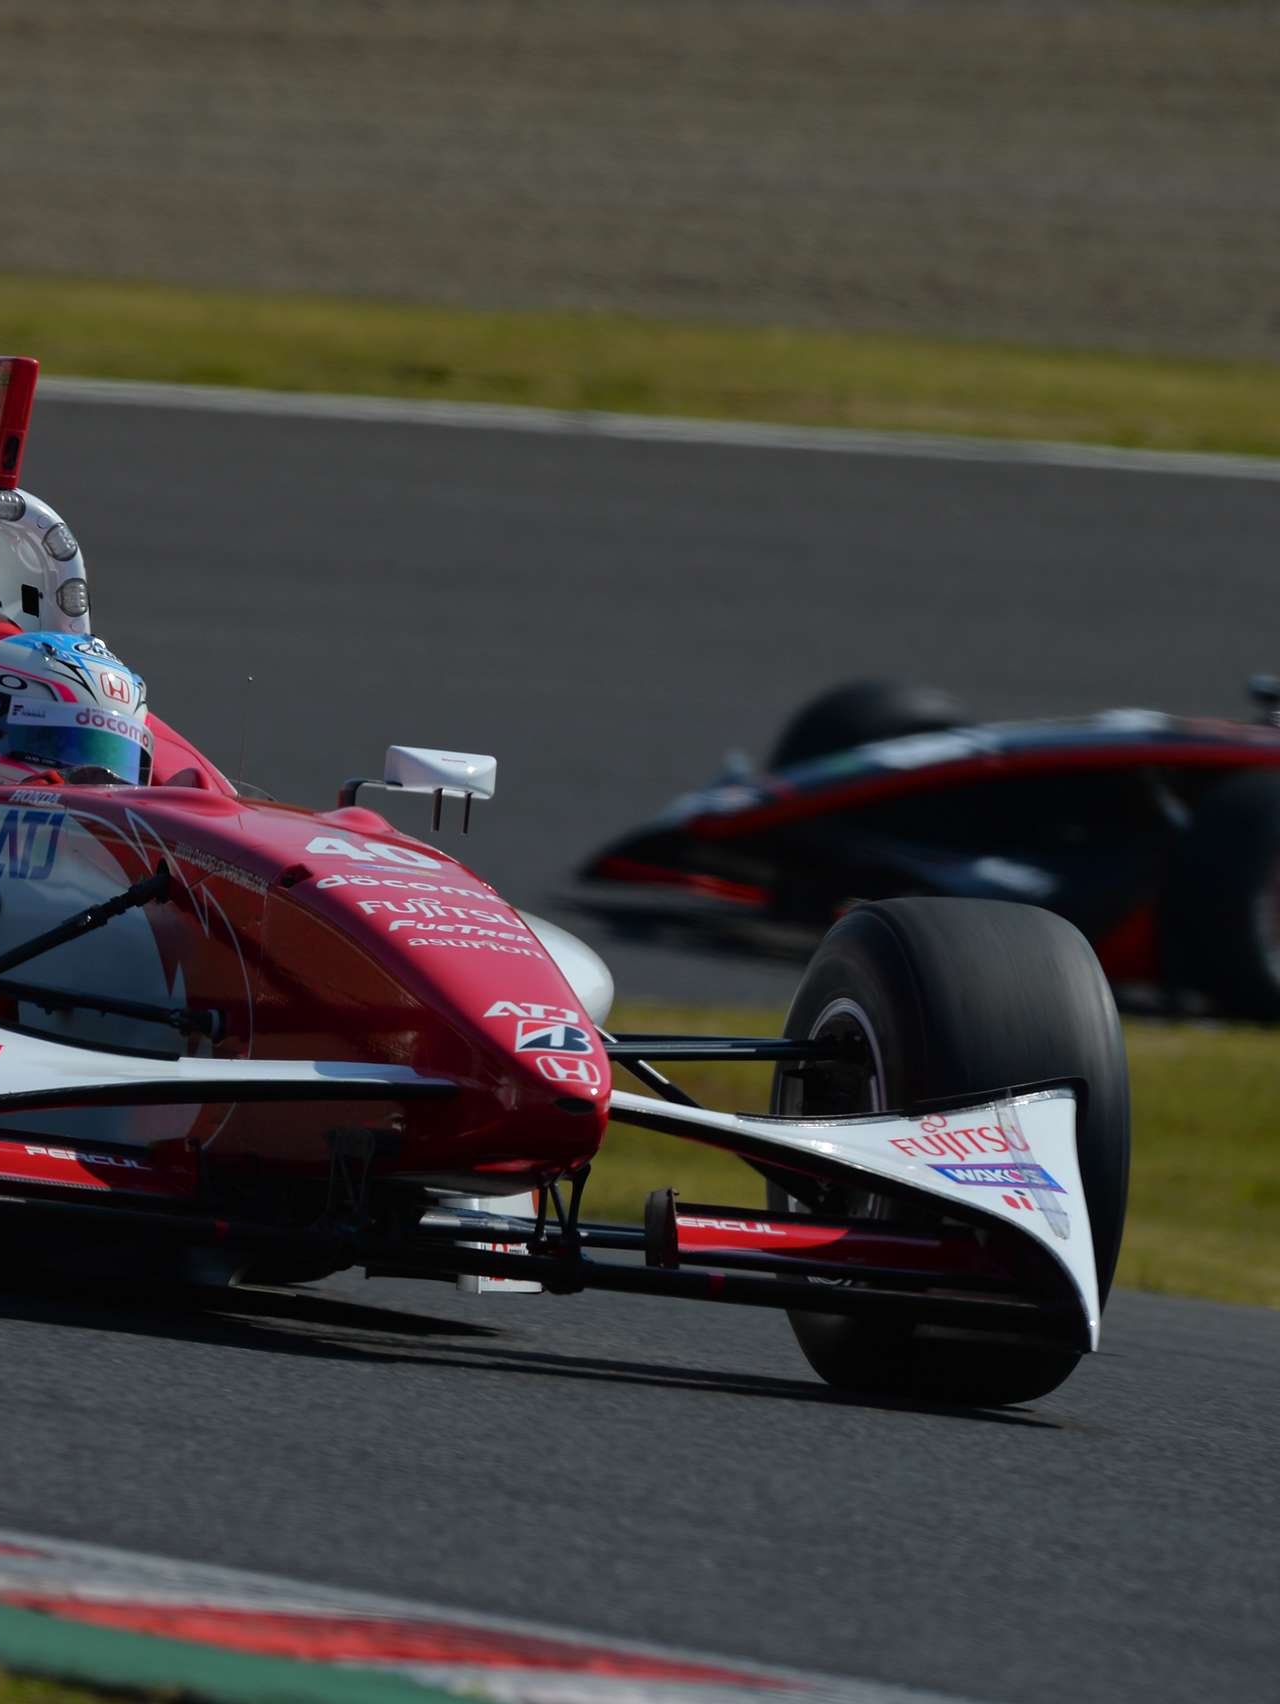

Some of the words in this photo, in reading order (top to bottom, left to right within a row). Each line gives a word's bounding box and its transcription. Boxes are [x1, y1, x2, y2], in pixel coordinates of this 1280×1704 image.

[76, 708, 150, 748] docomo
[9, 789, 62, 804] HONDA
[305, 836, 442, 870] 40
[356, 899, 527, 931] FUJITSU
[407, 937, 545, 960] asurion
[483, 1001, 579, 1024] ATJ
[888, 1125, 1030, 1162] FUJITSU
[24, 1145, 153, 1172] PERCUL
[677, 1216, 787, 1236] ERCUL
